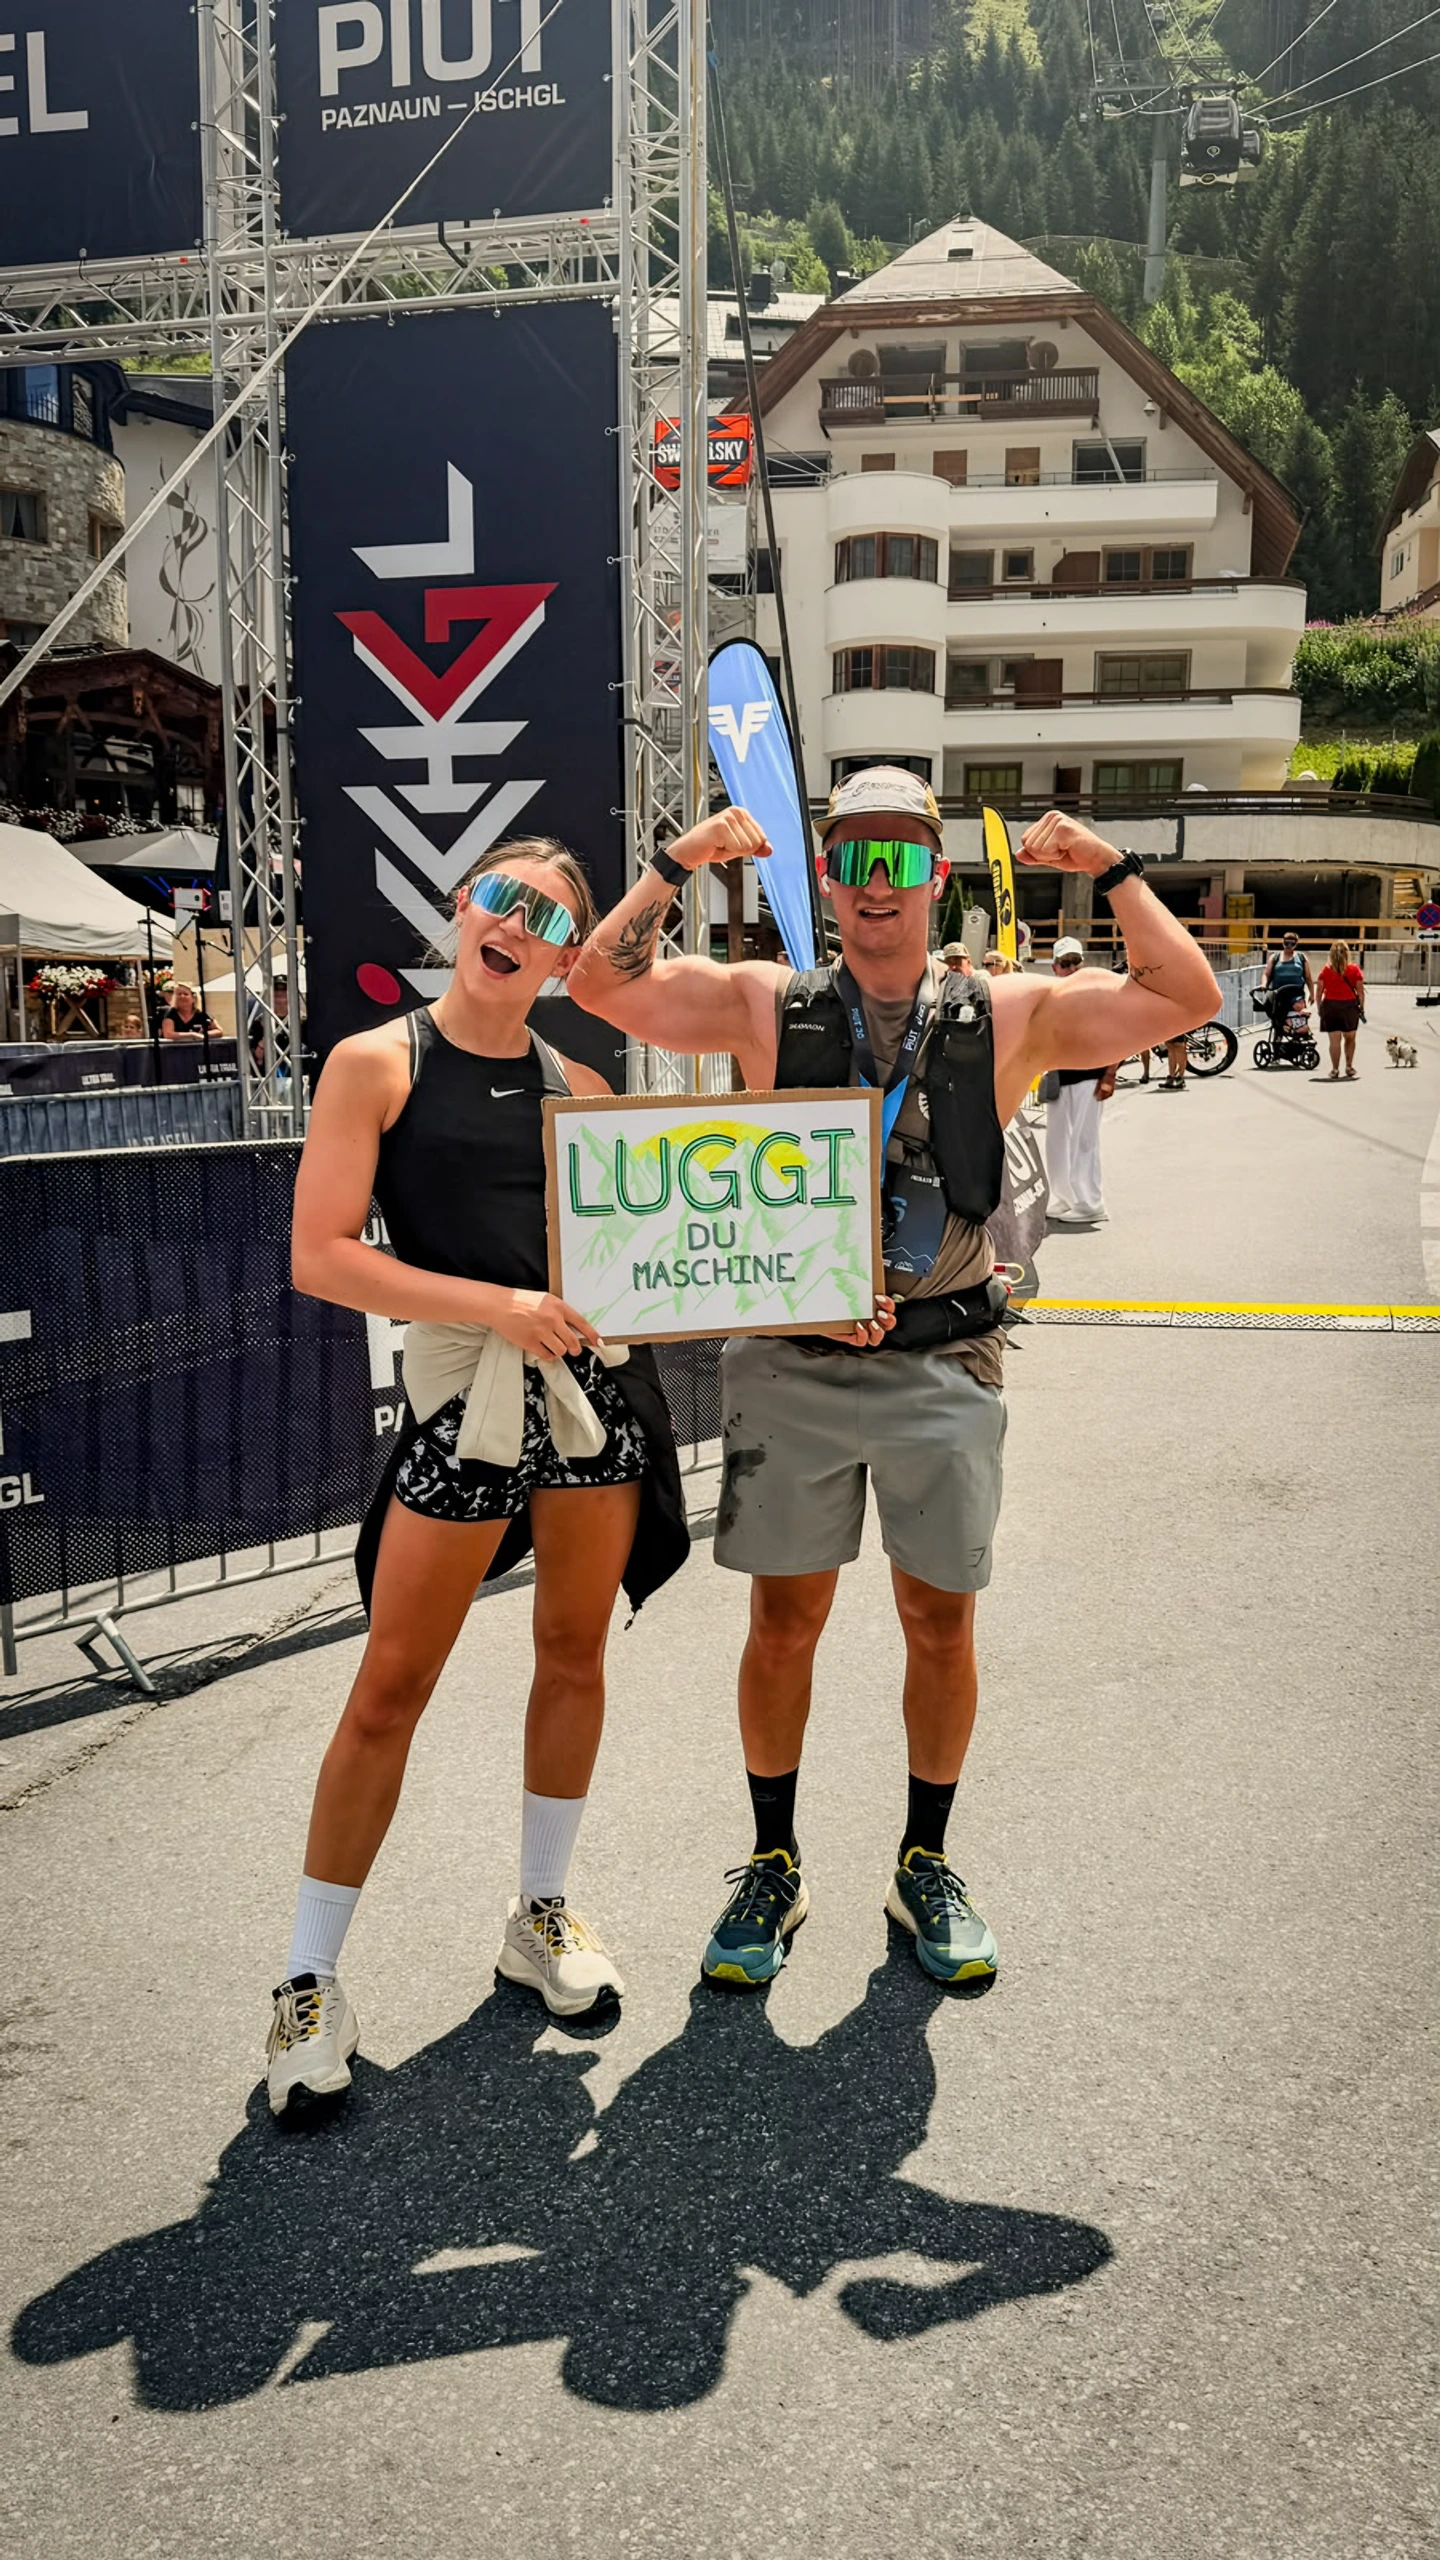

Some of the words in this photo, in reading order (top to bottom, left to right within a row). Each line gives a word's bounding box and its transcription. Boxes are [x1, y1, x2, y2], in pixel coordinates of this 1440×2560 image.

[321, 95, 441, 132] PAZNAUN
[474, 83, 566, 113] ISCHGL
[568, 1128, 857, 1217] LUGGI
[686, 1220, 736, 1251] DU
[631, 1252, 796, 1291] MASCHINE
